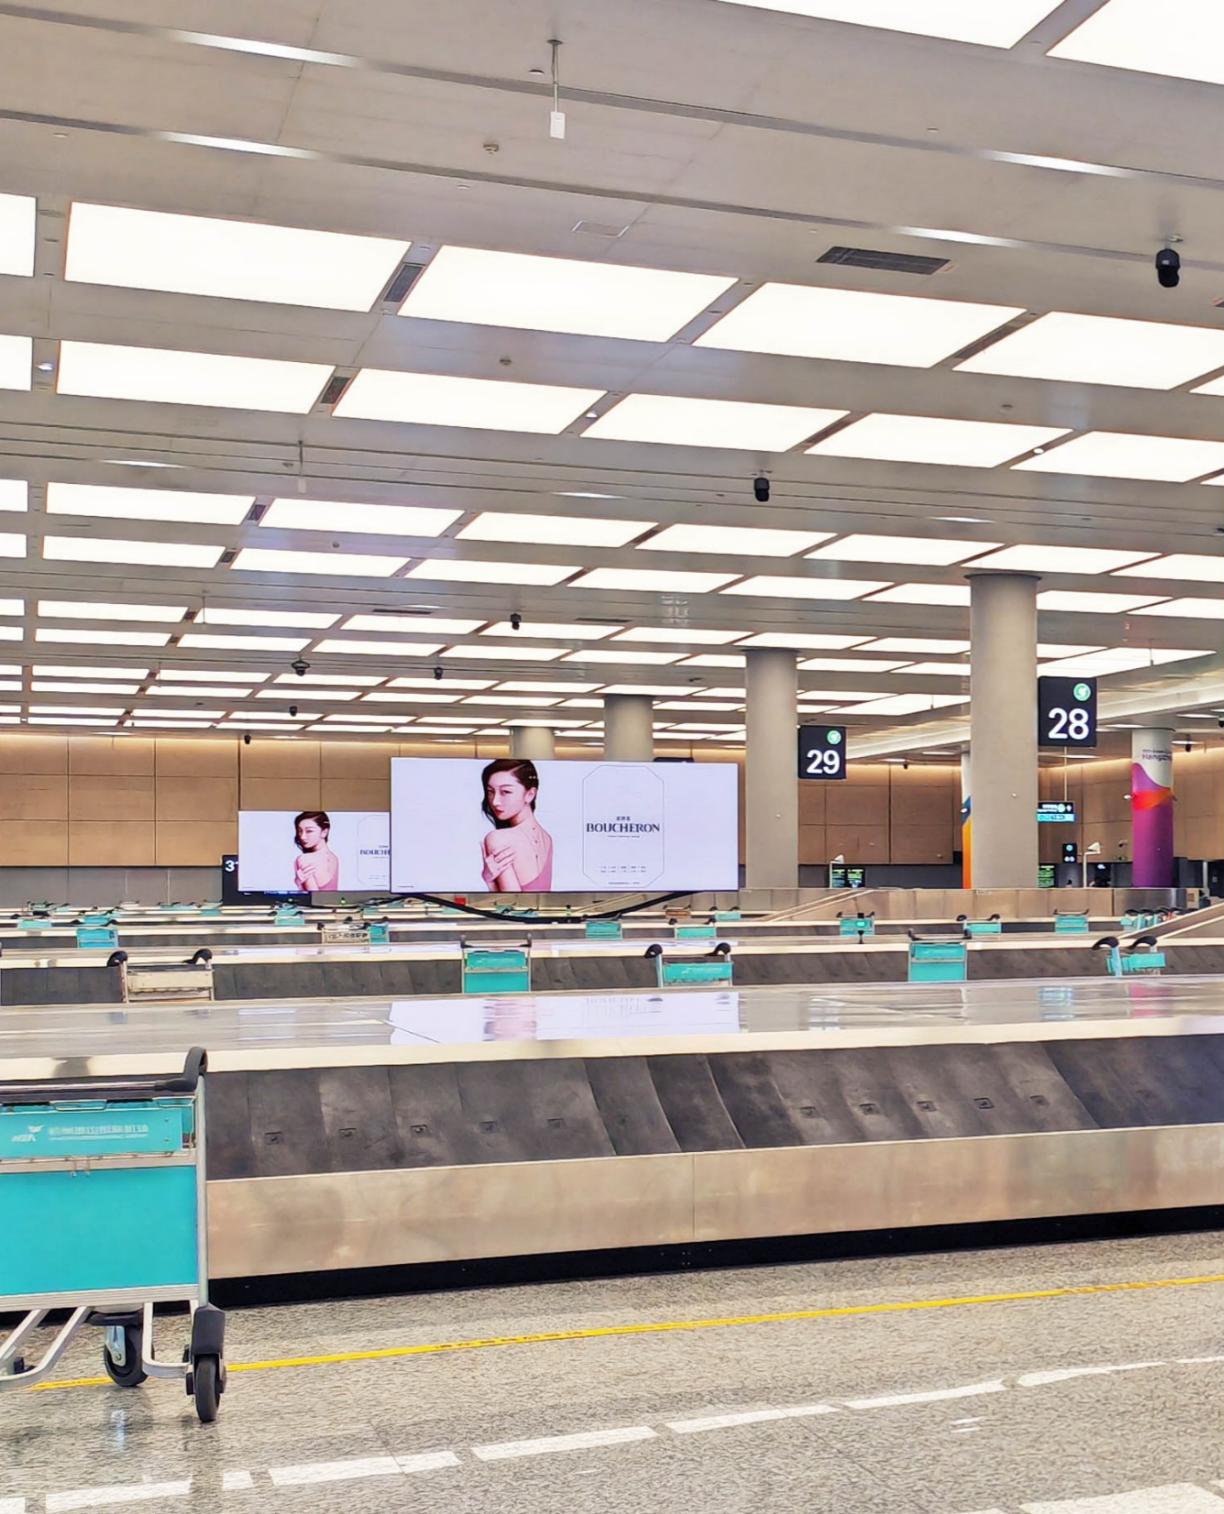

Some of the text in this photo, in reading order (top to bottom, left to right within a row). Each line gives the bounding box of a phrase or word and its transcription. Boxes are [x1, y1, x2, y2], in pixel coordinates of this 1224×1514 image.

[1048, 707, 1090, 740] 28
[806, 749, 840, 775] 29
[586, 822, 660, 833] BOUCHERON
[225, 860, 239, 872] 3
